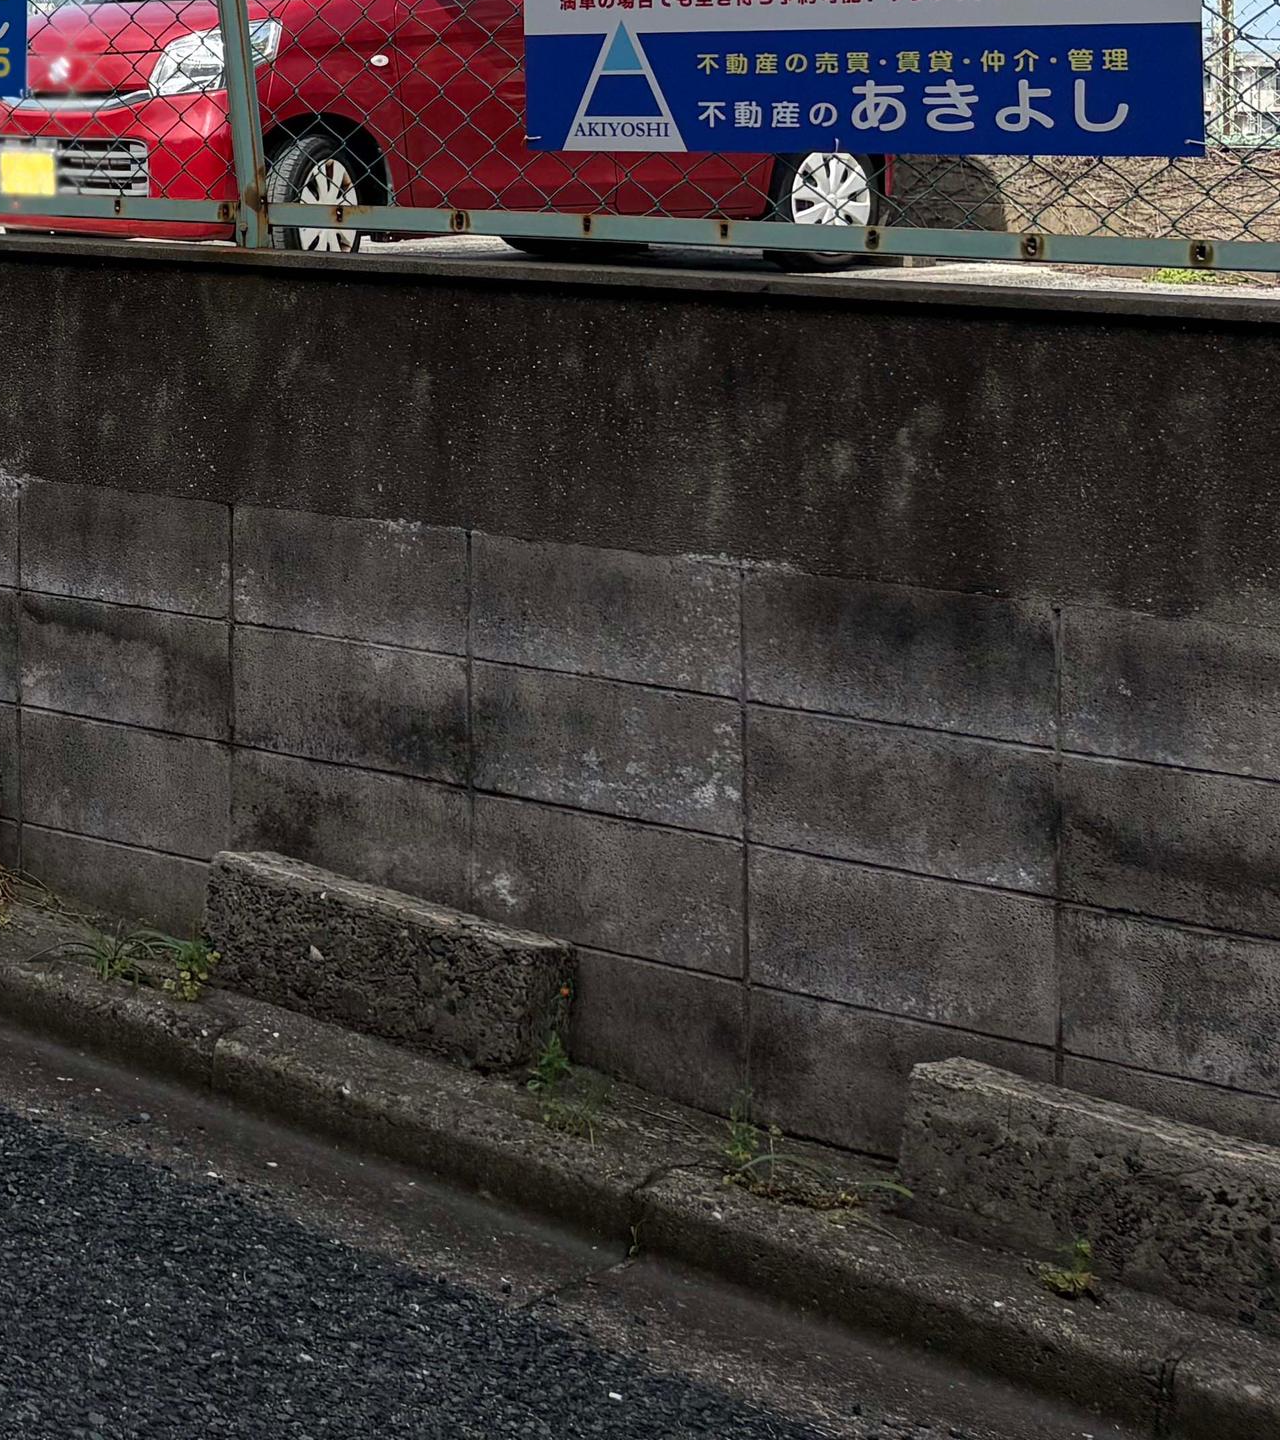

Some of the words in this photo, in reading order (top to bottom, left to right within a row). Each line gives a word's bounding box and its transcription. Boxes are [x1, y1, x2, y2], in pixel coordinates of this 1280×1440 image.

[696, 47, 1129, 75] 不動産の売買・賃貸・仲介・管理
[574, 121, 670, 138] AKIYOSHI
